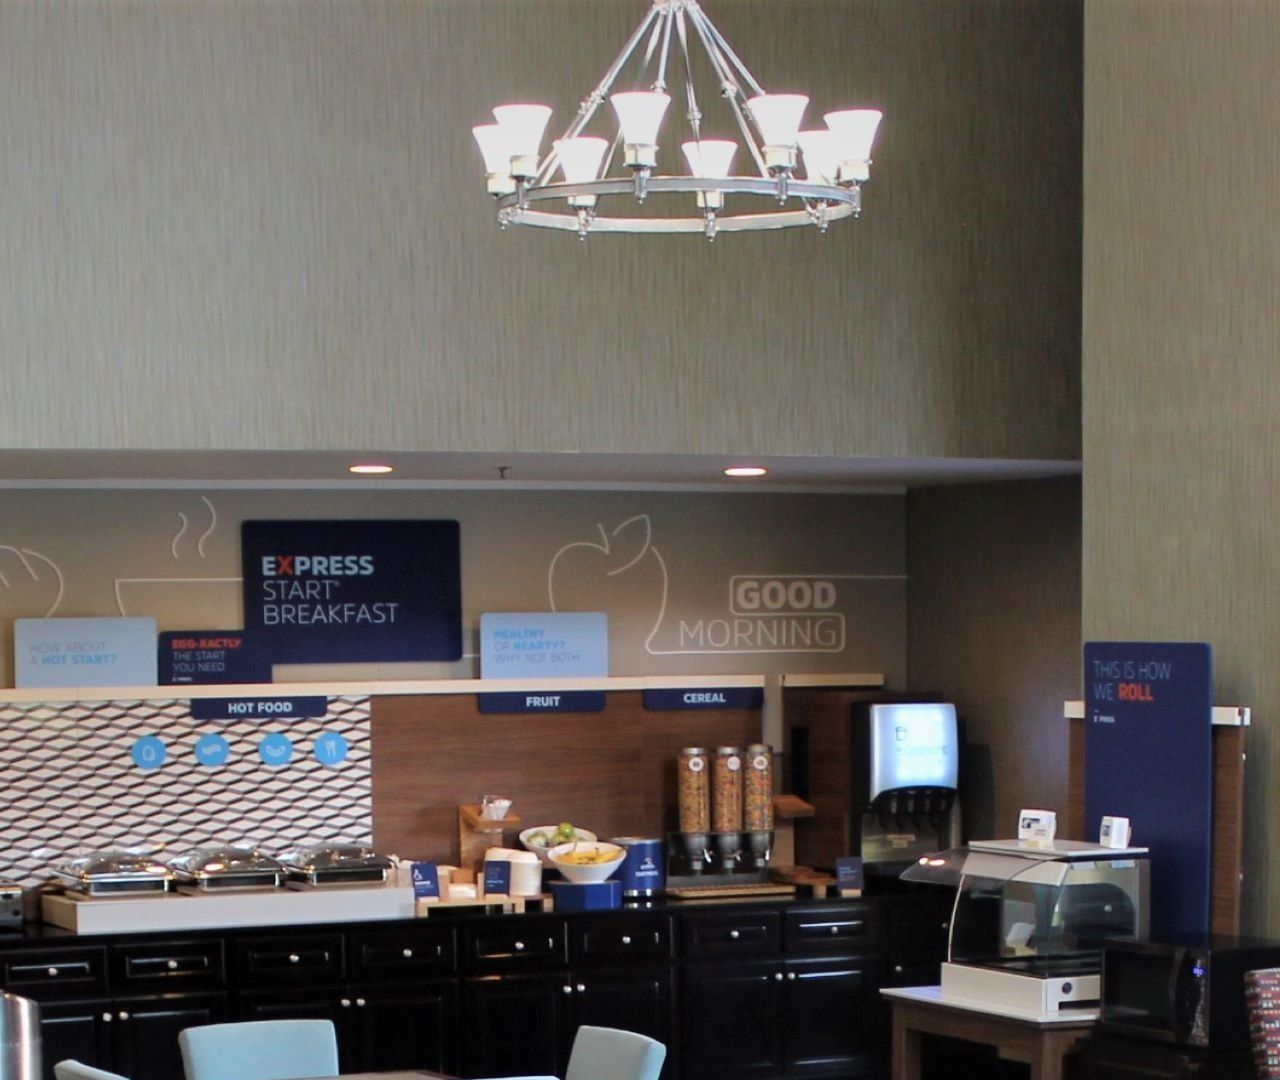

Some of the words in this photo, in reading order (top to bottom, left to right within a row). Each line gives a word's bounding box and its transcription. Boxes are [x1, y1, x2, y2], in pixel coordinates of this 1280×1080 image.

[262, 555, 374, 576] EXPRESS
[736, 580, 837, 610] GOOD
[263, 603, 399, 625] BREAKFAST
[494, 628, 545, 639] HEALTHY
[679, 619, 837, 647] MORNING
[29, 643, 59, 653] HOW
[65, 641, 106, 651] ABOUT
[513, 640, 566, 651] HEARTY?
[42, 655, 67, 665] HOT
[71, 653, 117, 665] START?
[173, 651, 192, 661] THE
[194, 650, 225, 661] START
[494, 653, 521, 663] WHY
[526, 652, 547, 663] NOT
[172, 662, 195, 673] YOU
[197, 662, 225, 673] NEED
[1093, 660, 1120, 679] THIS
[1124, 661, 1135, 680] IS
[1138, 661, 1172, 680] HOW
[1093, 683, 1115, 700] WE
[1117, 682, 1154, 701] ROLL
[525, 695, 561, 707] FRUIT
[683, 693, 726, 703] CEREAL
[227, 702, 255, 713] HOT
[257, 701, 293, 713] FOOD
